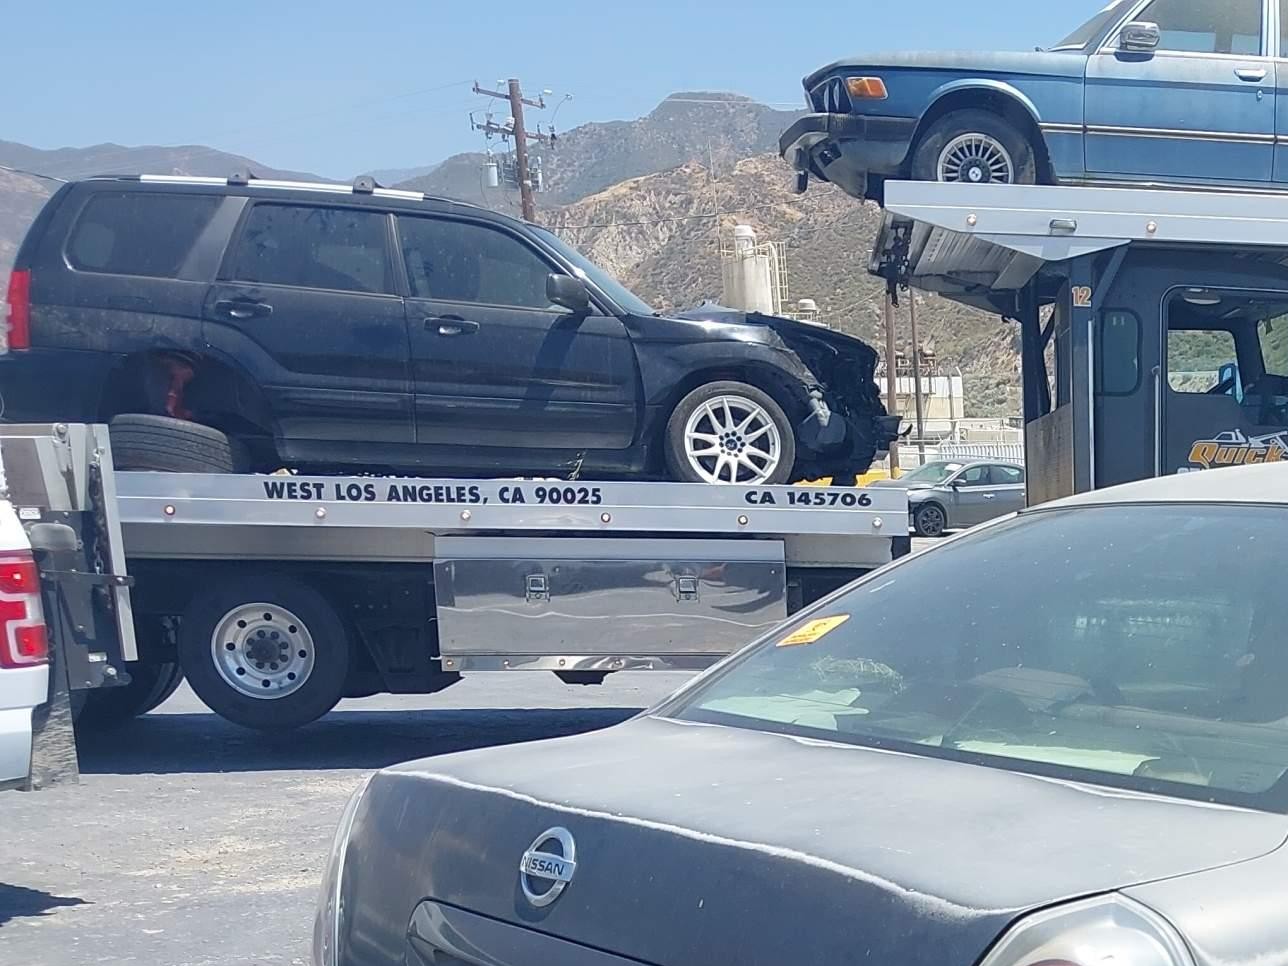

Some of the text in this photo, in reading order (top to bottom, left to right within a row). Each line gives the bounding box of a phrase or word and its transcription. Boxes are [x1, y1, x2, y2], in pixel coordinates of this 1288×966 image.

[1071, 286, 1092, 307] 12
[264, 481, 602, 504] WEST LOS ANGELES, CA 90025
[745, 491, 872, 507] CA 145706
[522, 855, 565, 876] NISSAN
